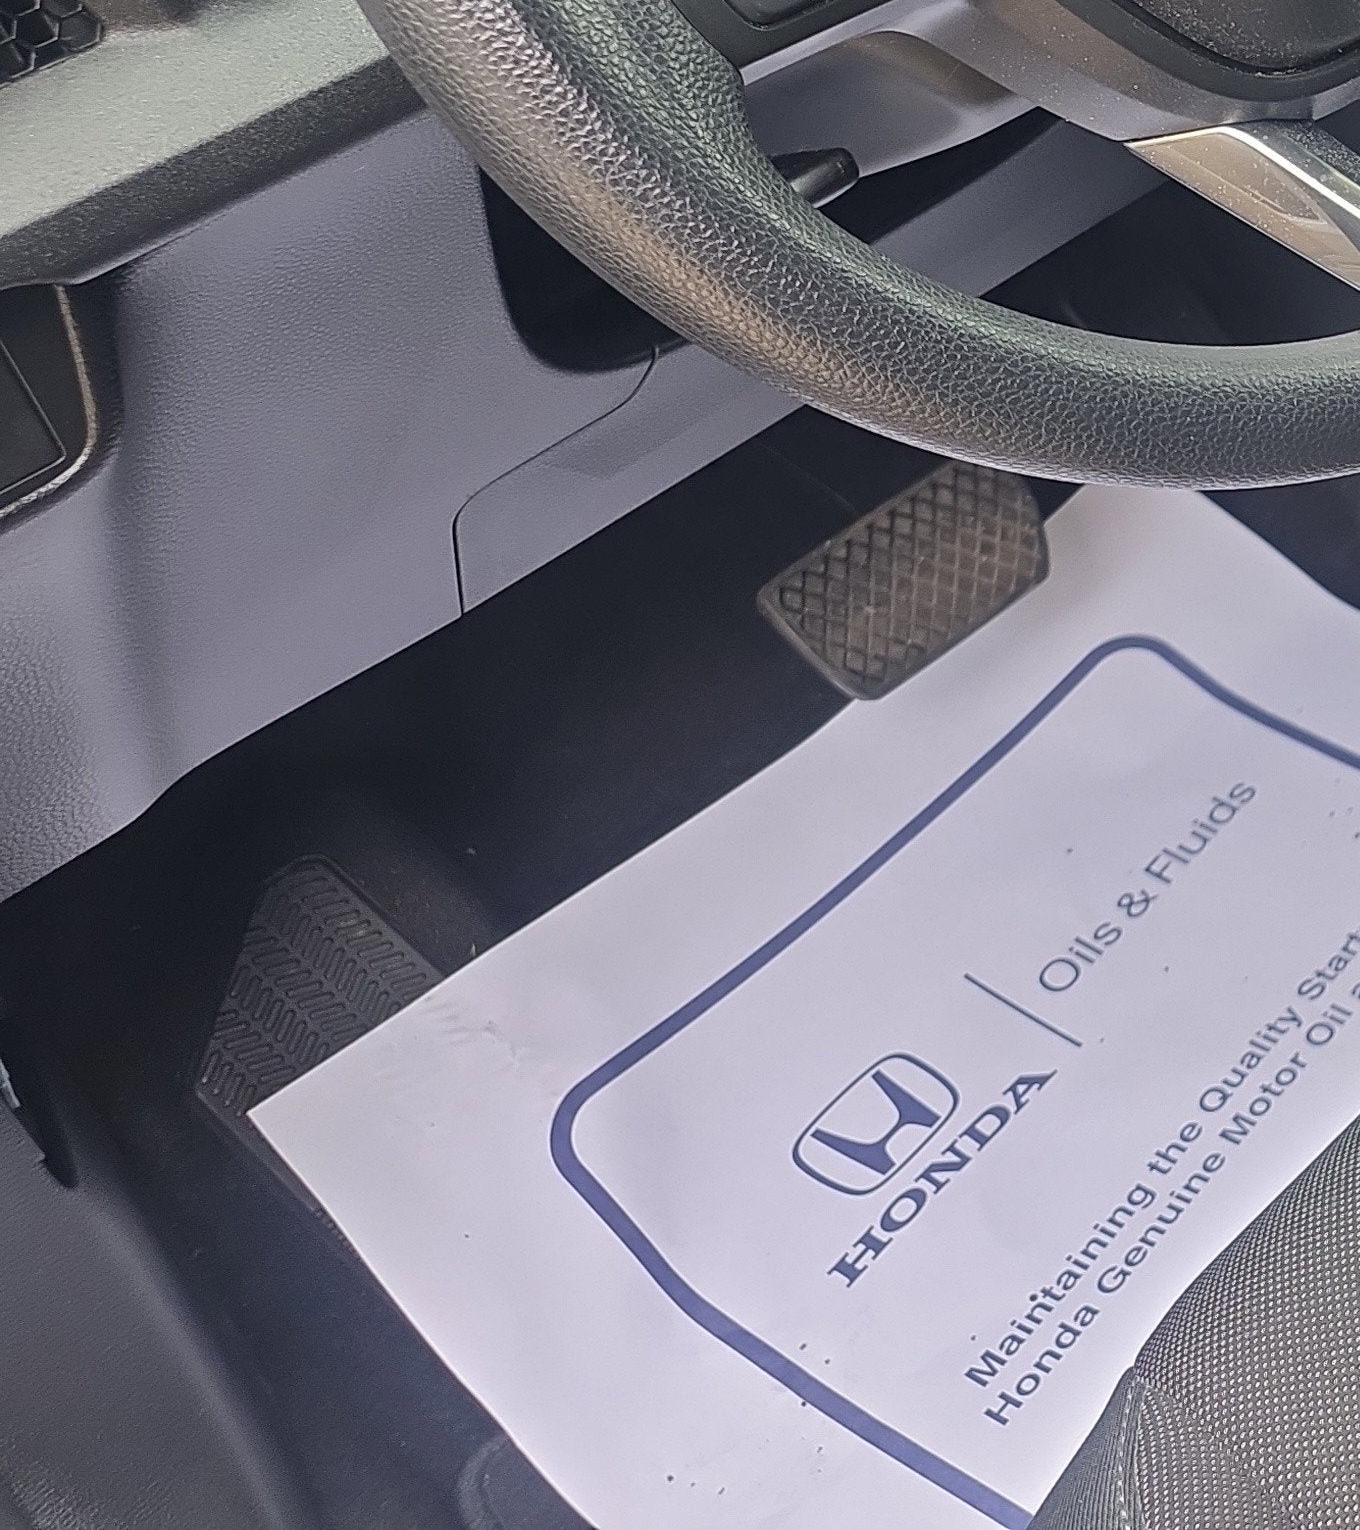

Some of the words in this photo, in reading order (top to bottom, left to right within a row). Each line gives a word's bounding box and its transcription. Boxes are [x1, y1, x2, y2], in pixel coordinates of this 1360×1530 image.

[1039, 922, 1122, 992] Oils
[1117, 889, 1159, 918] &
[1144, 782, 1256, 884] Fluids
[827, 1069, 1058, 1288] HONDA
[964, 1183, 1157, 1387] Maintaining
[1148, 1121, 1203, 1175] the
[1199, 1006, 1303, 1113] Quality
[984, 1303, 1101, 1426] Honda
[1096, 1152, 1227, 1294] Genuine
[1219, 1051, 1308, 1146] Motor
[1305, 1003, 1353, 1046] Oil
